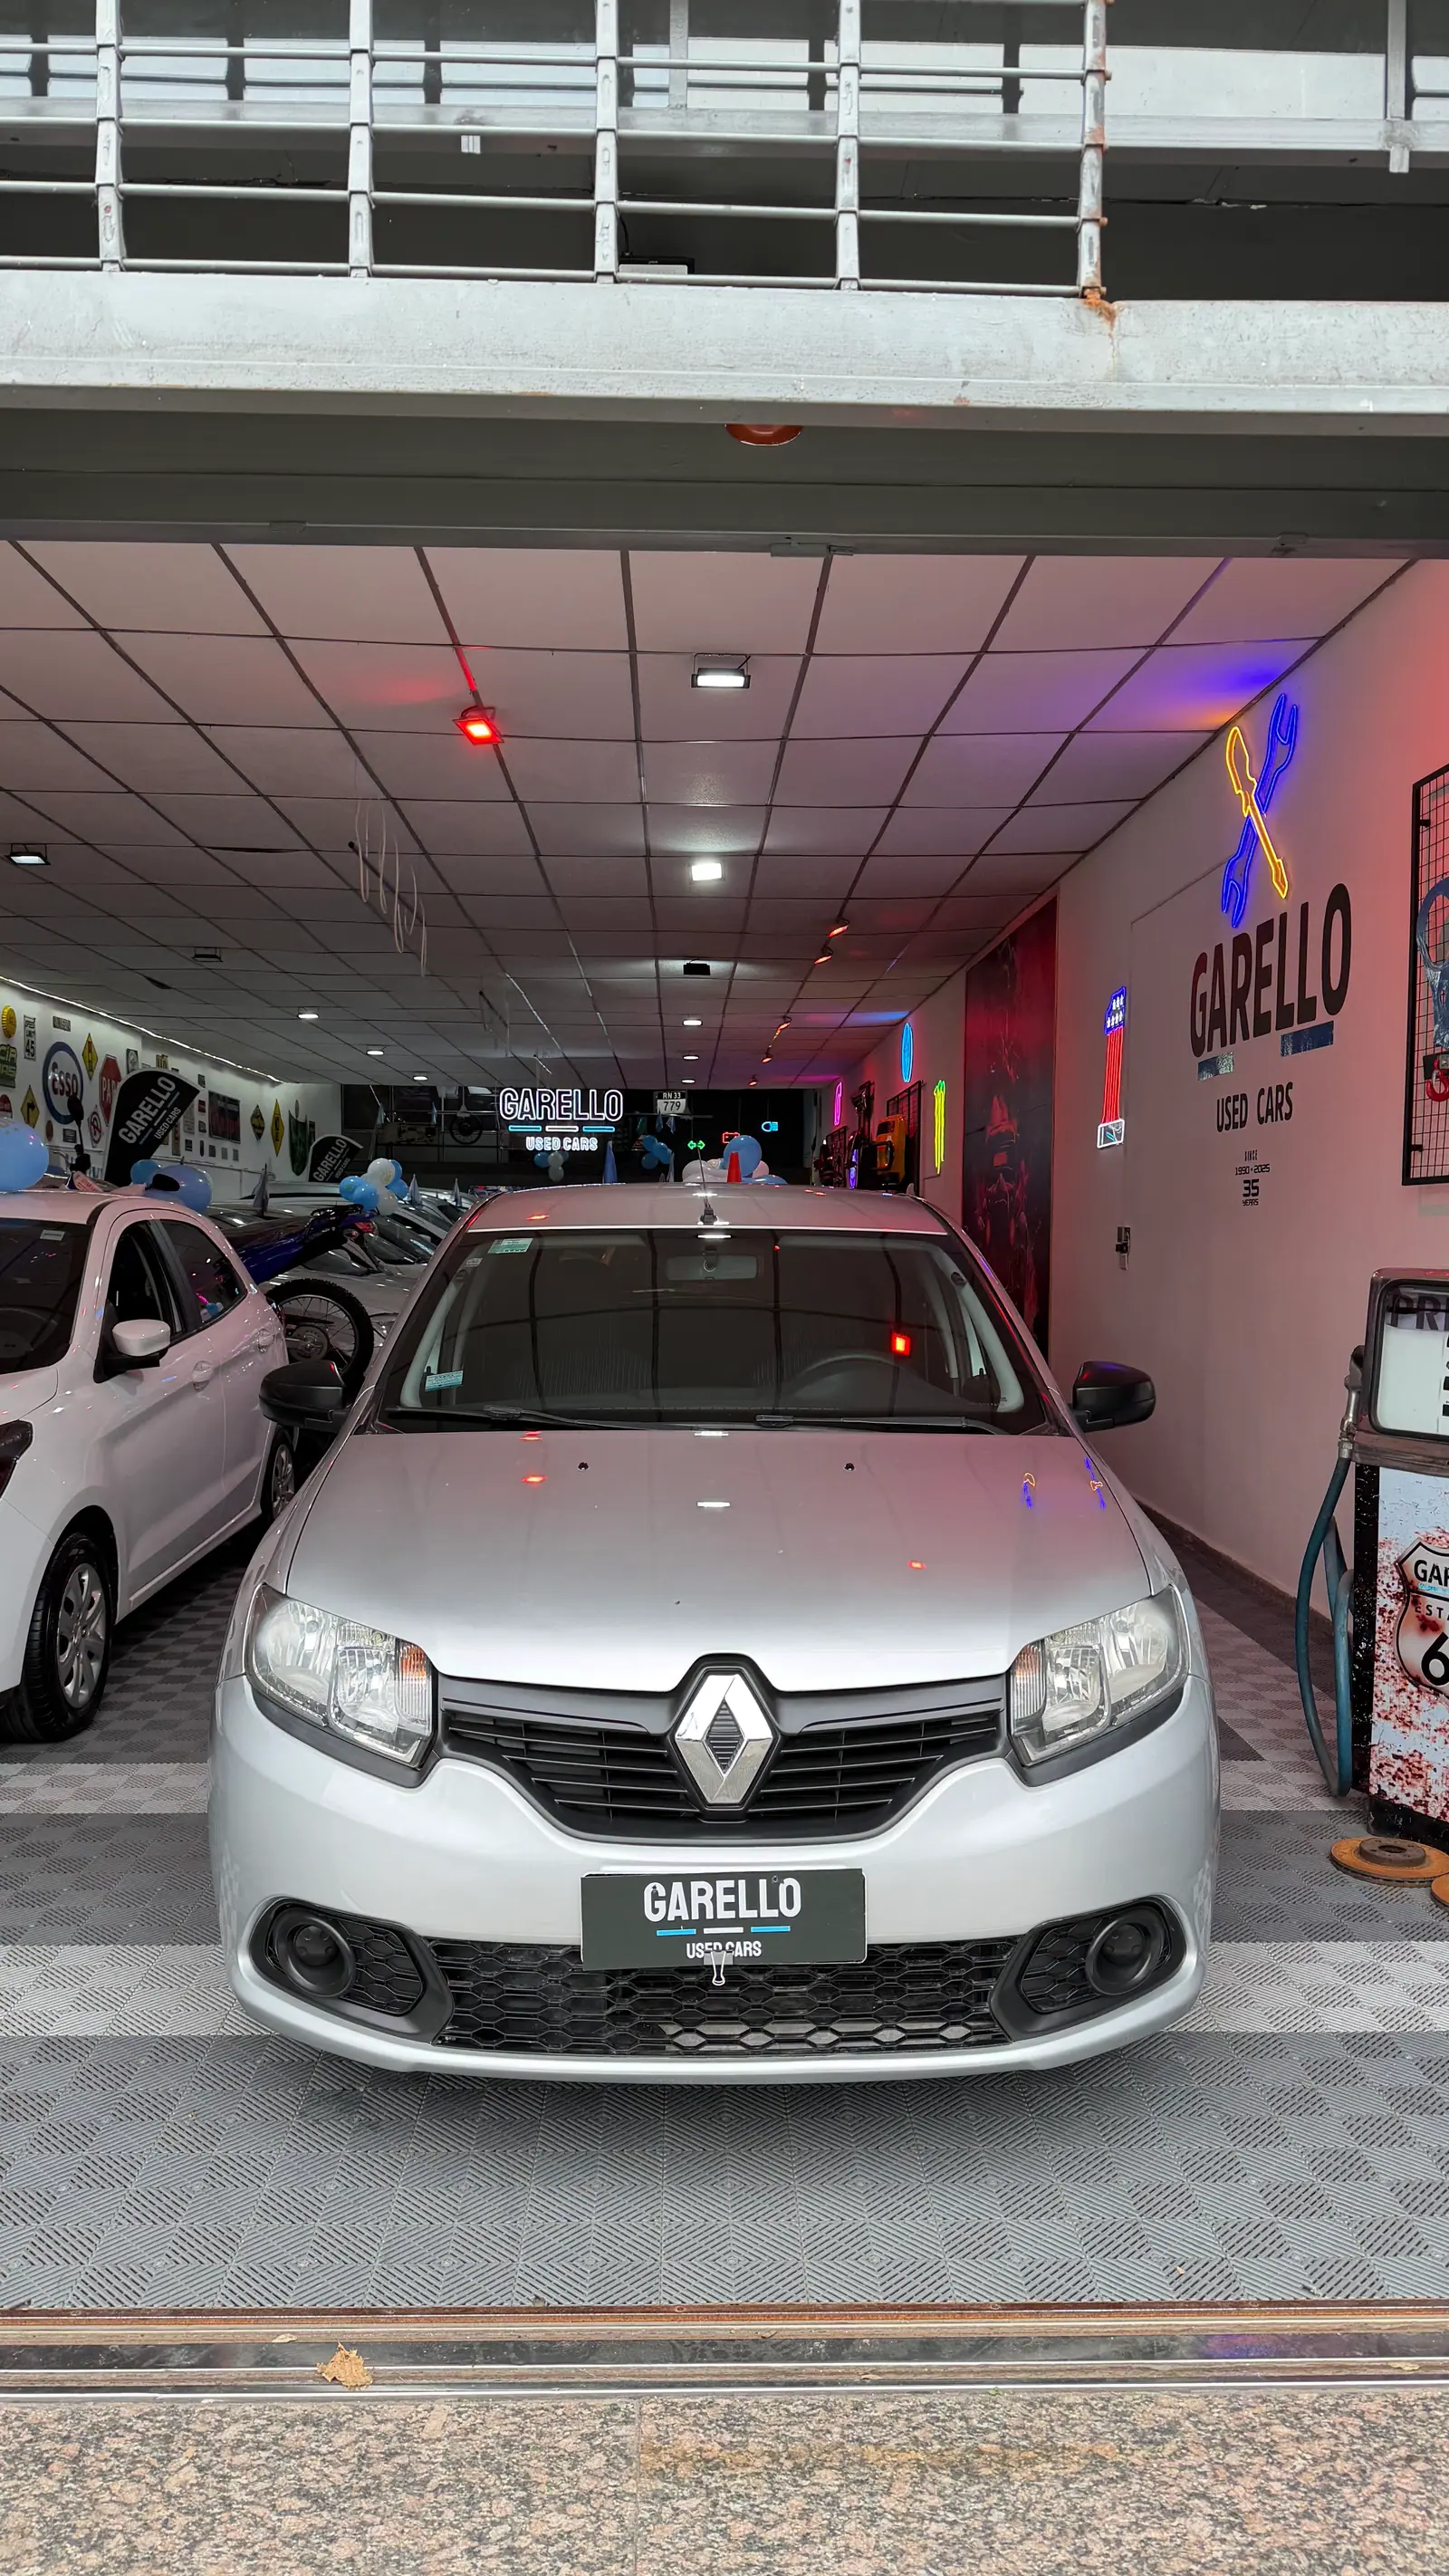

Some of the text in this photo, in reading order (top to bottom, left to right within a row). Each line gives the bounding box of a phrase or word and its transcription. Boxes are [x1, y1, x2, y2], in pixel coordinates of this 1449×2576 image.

[1190, 883, 1351, 1057] GARELLO
[26, 1039, 35, 1057] 45
[118, 1076, 176, 1144] GARELLO
[499, 1088, 623, 1121] GARELLO
[663, 1101, 681, 1111] 779
[1216, 1081, 1293, 1132] USED CARS
[154, 1107, 181, 1139] USED CARS
[525, 1136, 598, 1151] USED CARS
[312, 1139, 348, 1181] GARELLO
[1242, 1198, 1259, 1206] YEARS
[1243, 1178, 1260, 1197] 35
[1391, 1294, 1449, 1331] PR
[1415, 1602, 1449, 1620] EST
[644, 1878, 801, 1922] GARELLO
[686, 1941, 762, 1958] USED CARS
